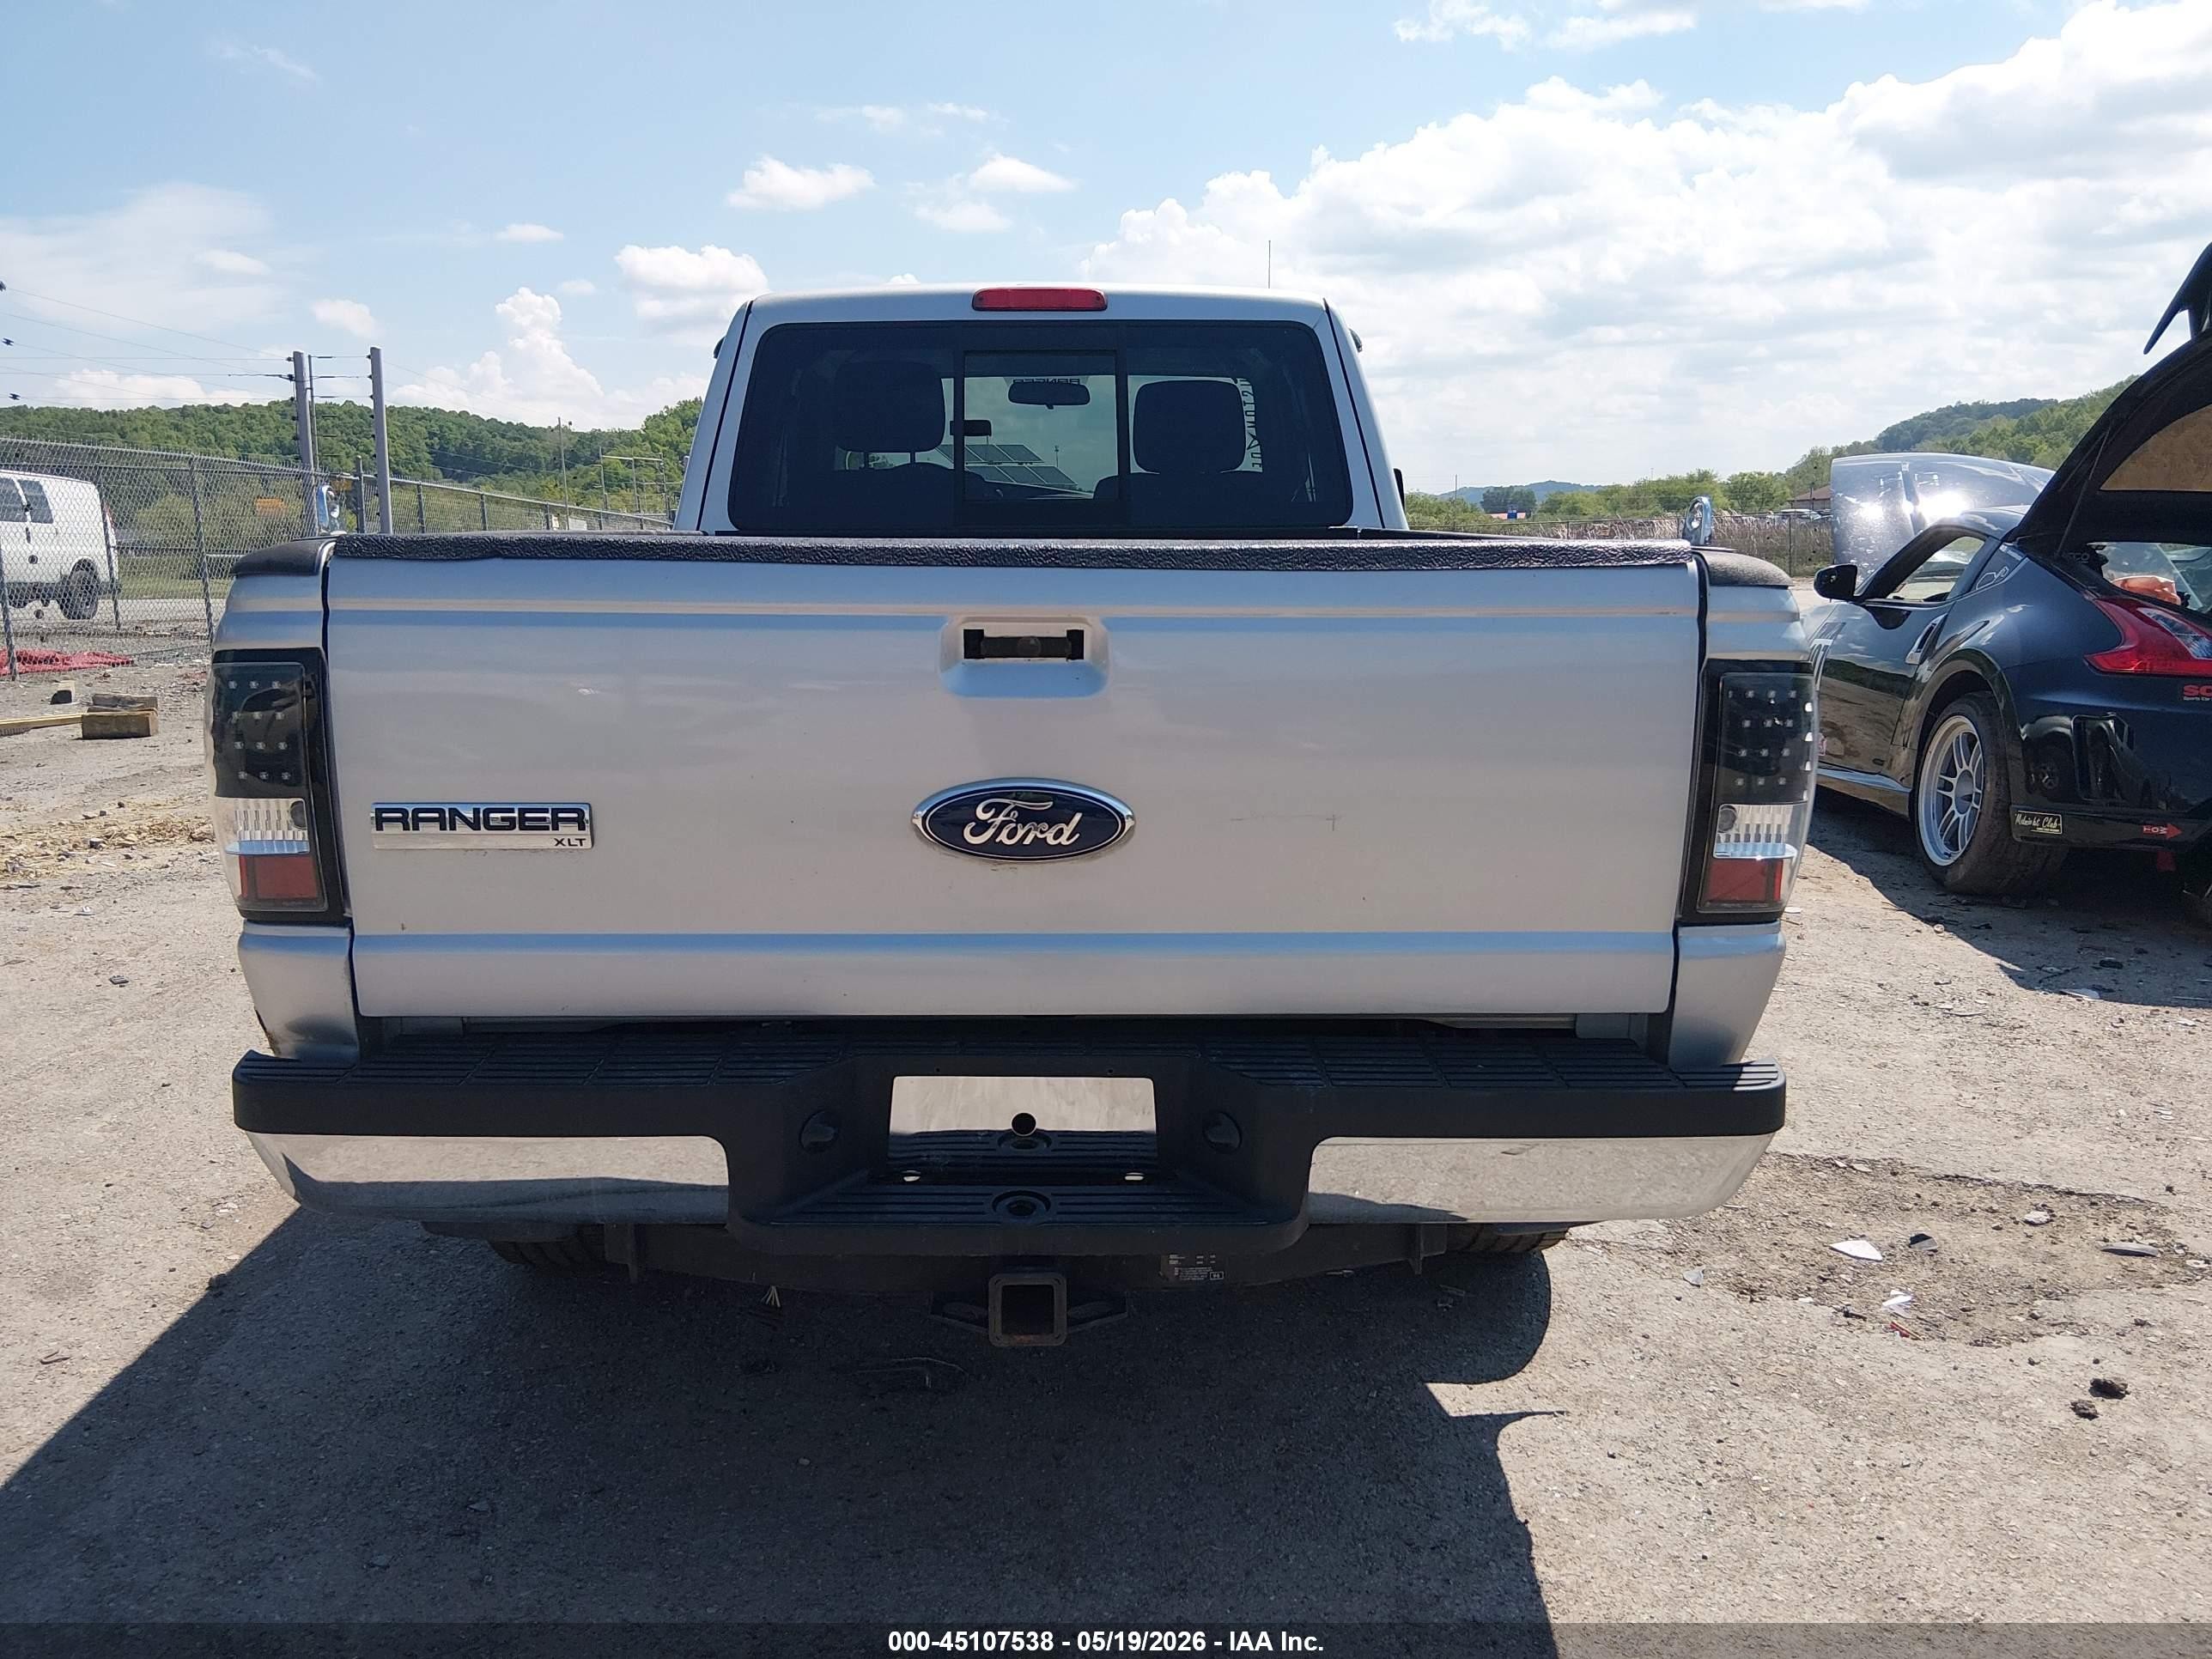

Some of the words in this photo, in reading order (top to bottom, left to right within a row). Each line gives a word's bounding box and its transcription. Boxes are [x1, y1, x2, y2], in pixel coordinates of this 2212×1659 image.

[375, 807, 586, 831] RANGER
[963, 798, 1083, 846] Ford
[554, 838, 586, 847] XLT
